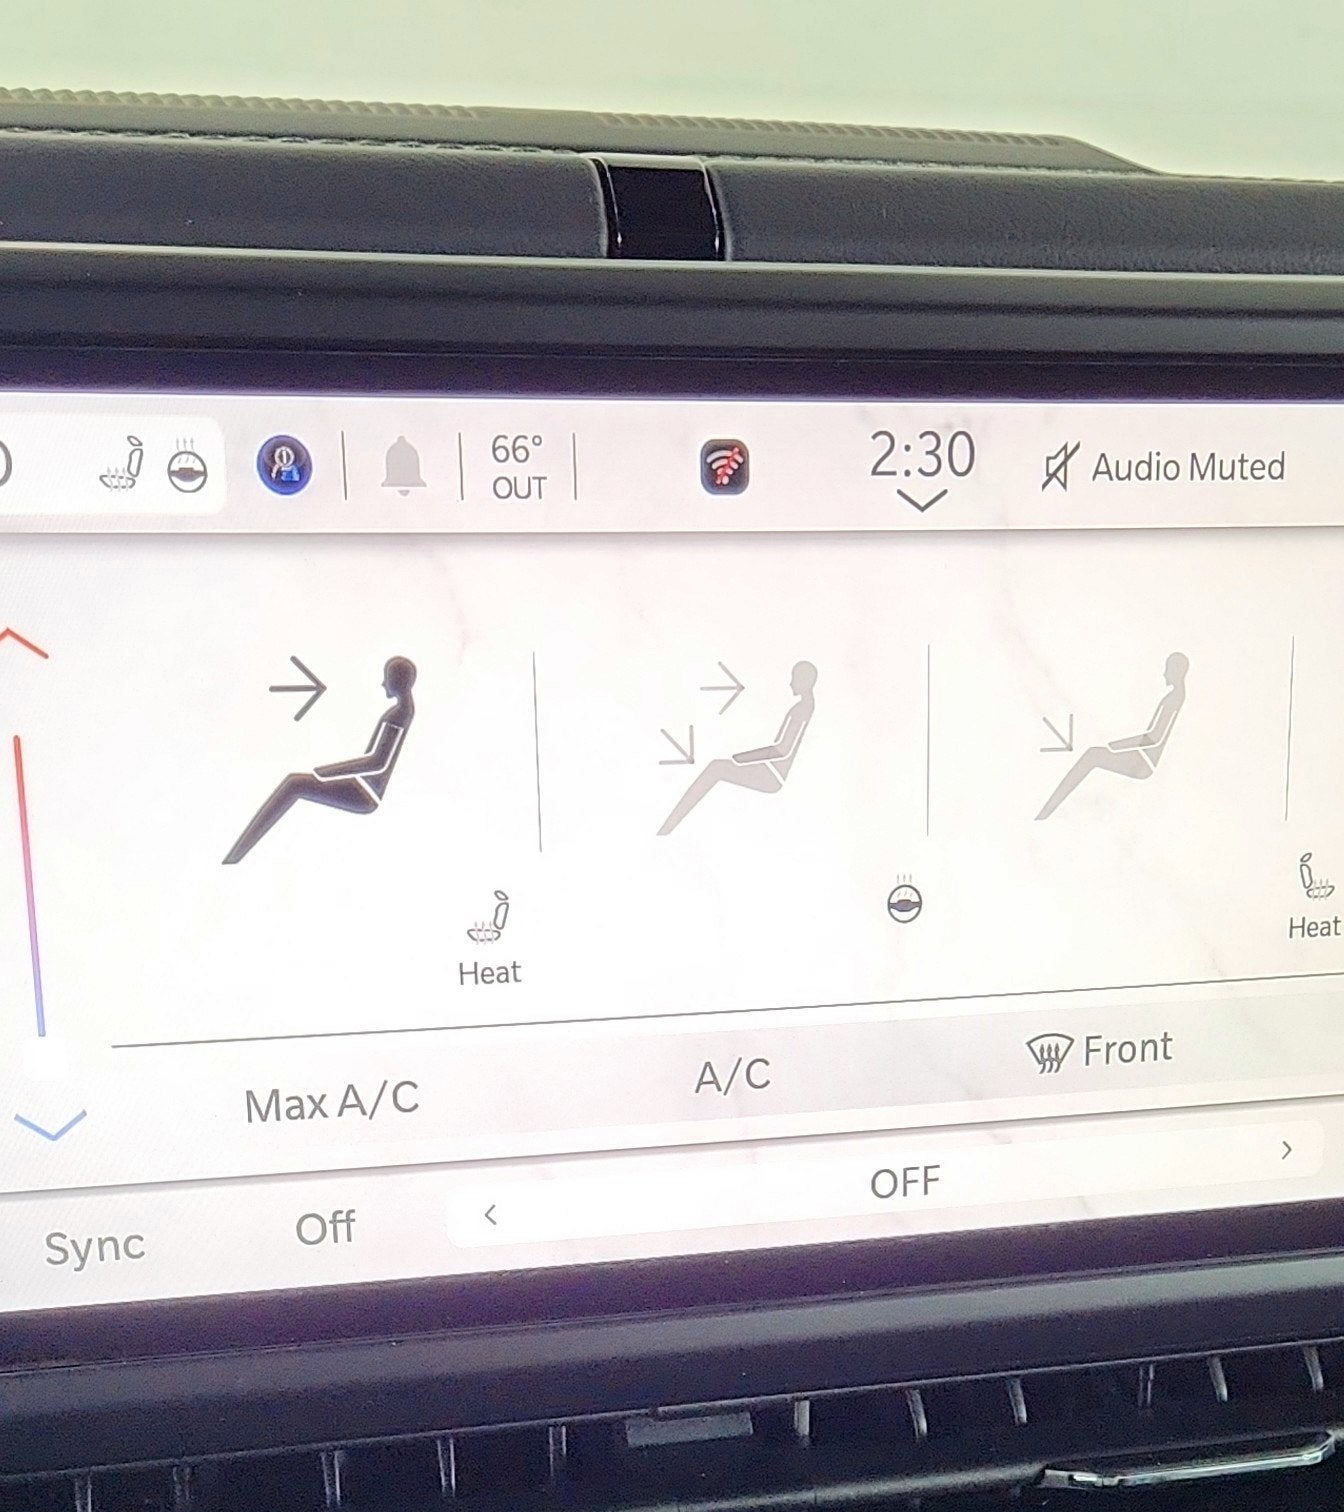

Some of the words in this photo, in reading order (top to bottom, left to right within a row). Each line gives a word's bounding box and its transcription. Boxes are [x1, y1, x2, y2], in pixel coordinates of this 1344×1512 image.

[869, 429, 977, 478] 2:30
[1091, 450, 1181, 483] Audio
[1188, 449, 1287, 482] Muted
[492, 476, 547, 500] OUT
[1288, 914, 1342, 940] Heat
[458, 960, 523, 986] Heat
[1083, 1030, 1174, 1068] Front
[694, 1056, 772, 1096] A/C
[245, 1087, 328, 1124] Max
[337, 1079, 420, 1121] A/C
[870, 1164, 942, 1200] OFF
[295, 1209, 357, 1247] Off
[45, 1230, 147, 1272] Sync
